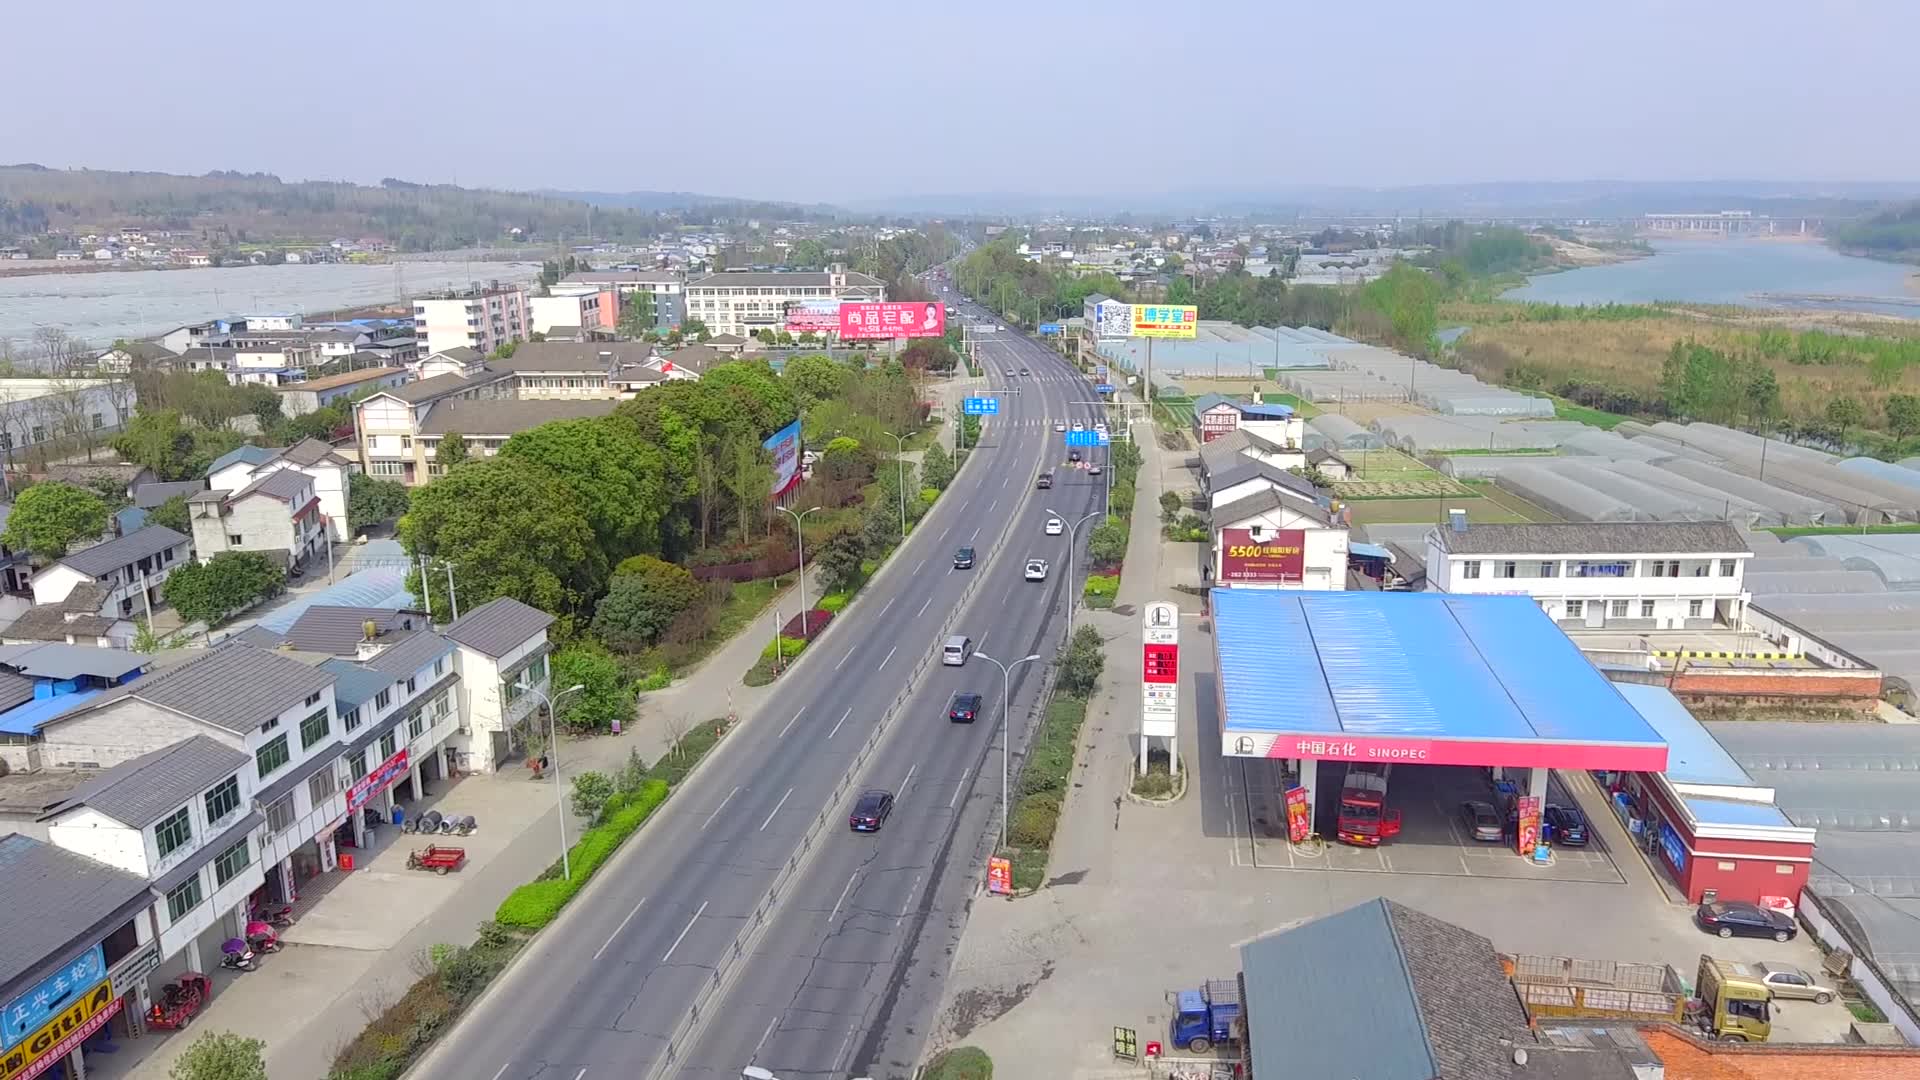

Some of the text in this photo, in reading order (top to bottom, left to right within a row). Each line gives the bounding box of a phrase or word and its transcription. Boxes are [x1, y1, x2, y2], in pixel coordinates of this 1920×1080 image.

[848, 311, 914, 325] 尚品宅配
[1144, 308, 1184, 323] 博学堂
[1229, 545, 1262, 558] 5500
[1296, 740, 1427, 759] 中国石化 SINOPEC
[12, 962, 87, 1026] 正兴车轮
[30, 1006, 83, 1054] Giti
